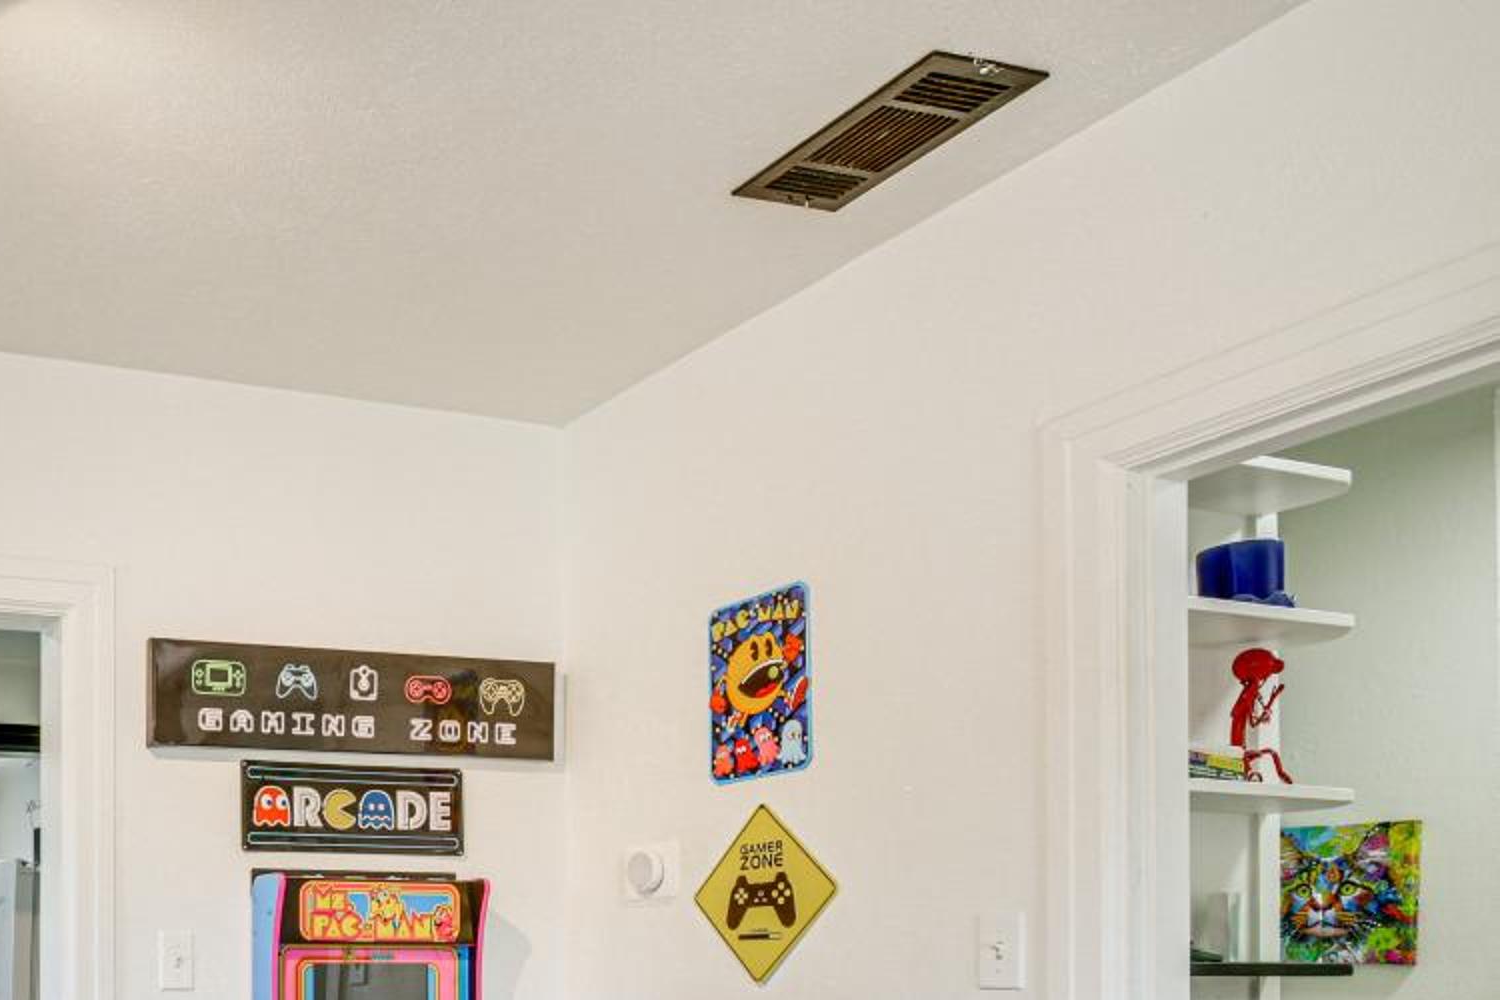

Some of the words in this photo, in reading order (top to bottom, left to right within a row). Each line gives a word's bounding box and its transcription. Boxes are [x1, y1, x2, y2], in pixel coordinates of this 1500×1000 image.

[197, 707, 375, 738] GAMING
[409, 717, 517, 746] ZONE
[252, 784, 453, 832] ARCADE
[740, 840, 783, 855] GAMER
[740, 854, 783, 870] ZONE
